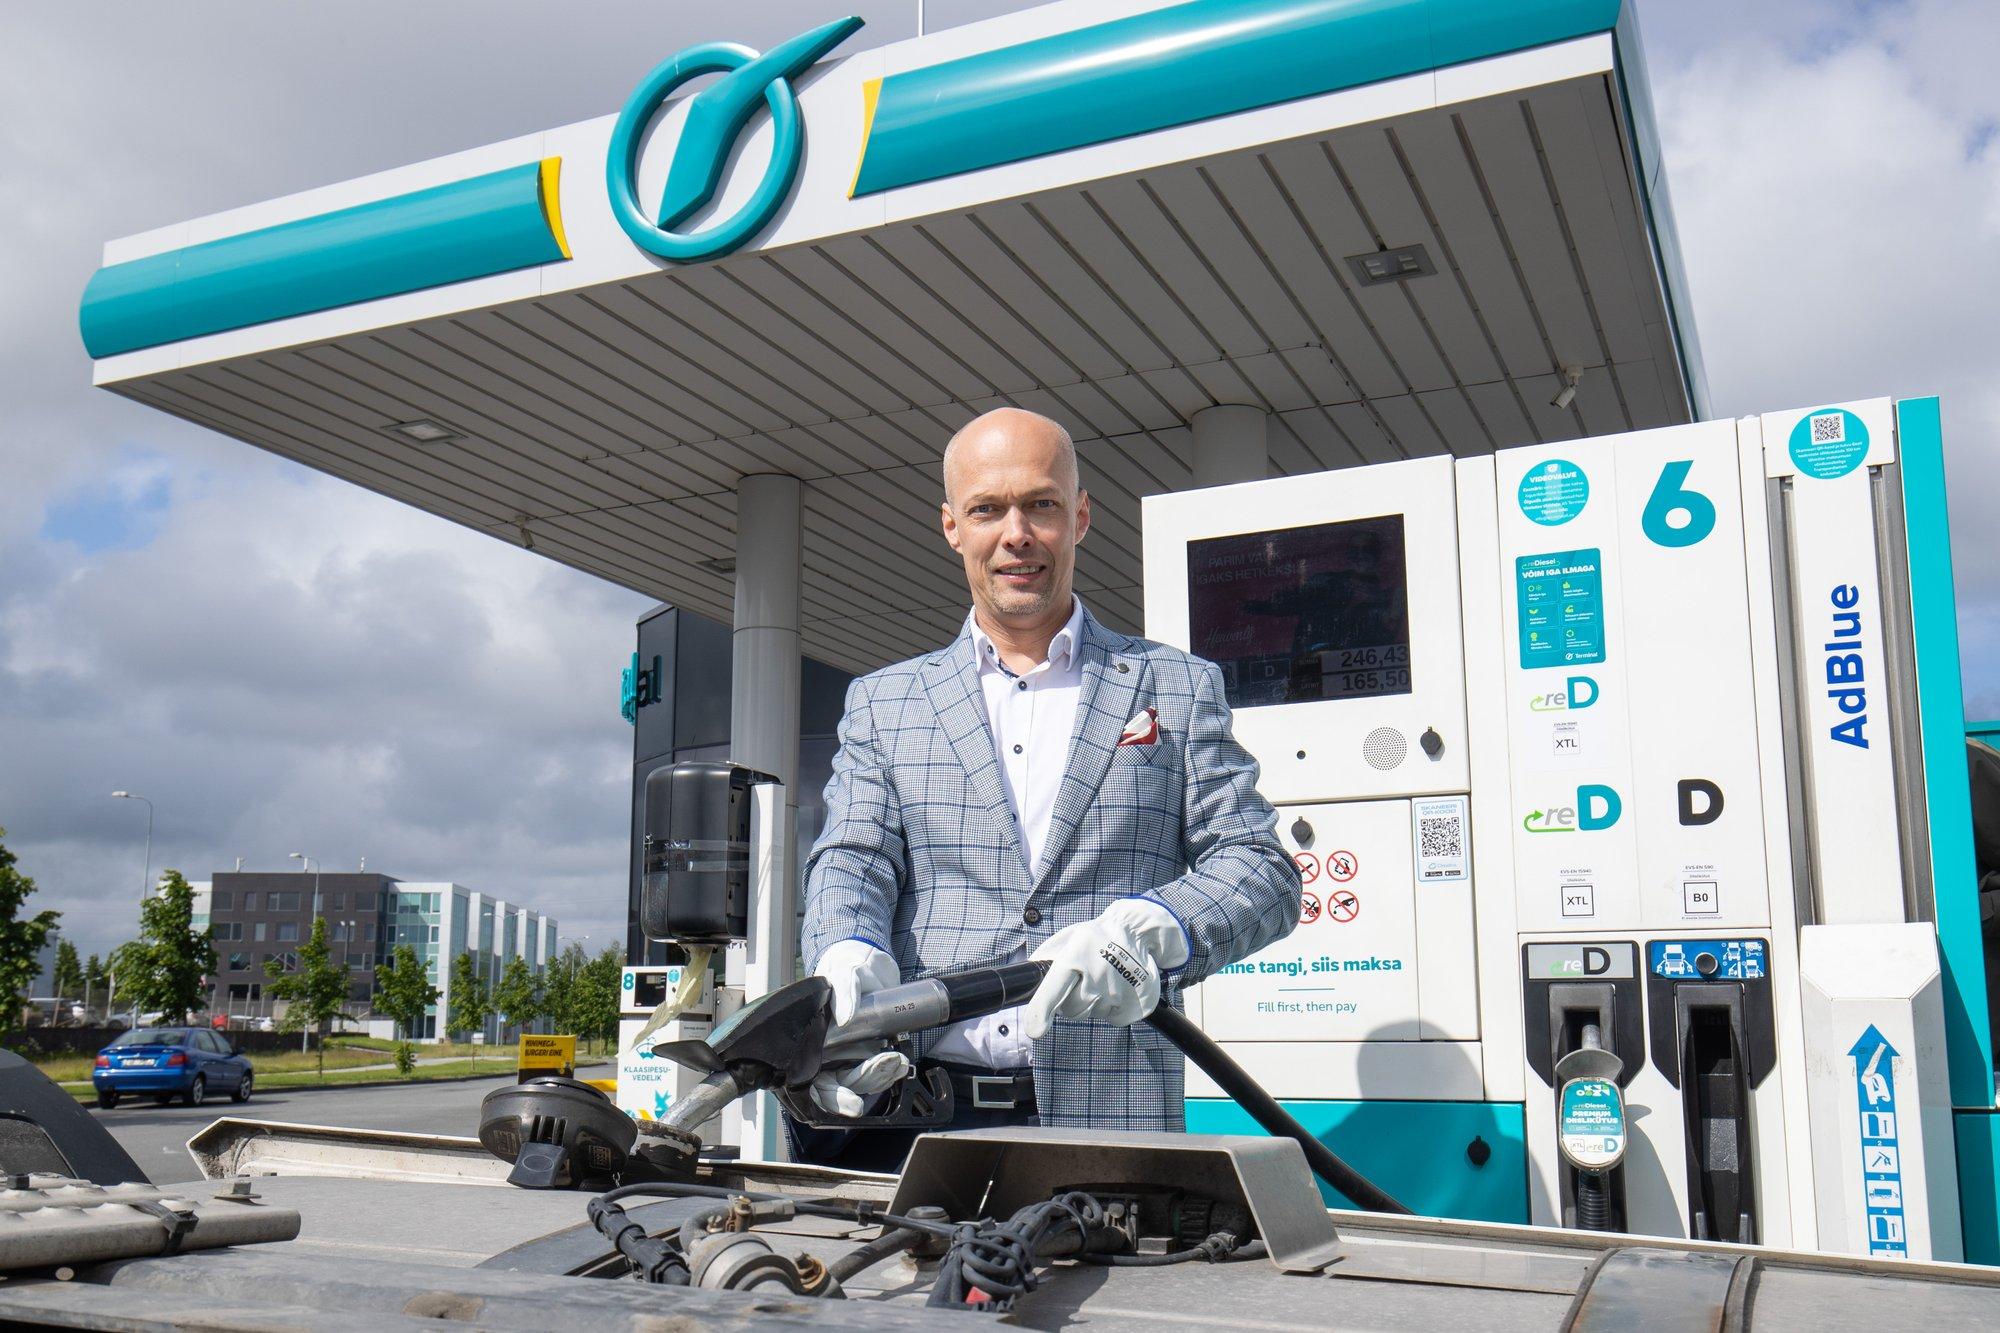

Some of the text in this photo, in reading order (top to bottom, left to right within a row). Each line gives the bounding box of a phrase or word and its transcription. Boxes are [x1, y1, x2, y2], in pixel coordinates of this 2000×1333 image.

[1529, 471, 1578, 483] VIDEOVALVE
[1642, 460, 1716, 548] 6
[1522, 564, 1596, 578] VÕIM IGA ILMAGA
[1341, 646, 1408, 668] 246,43
[1824, 584, 1870, 749] AdBlue
[1342, 669, 1409, 691] 165,50
[1545, 676, 1600, 710] reD
[1556, 738, 1578, 748] XTL
[1544, 784, 1622, 832] reD
[1678, 778, 1724, 826] D
[1566, 896, 1588, 906] XTL
[1694, 893, 1708, 902] B0
[1217, 957, 1402, 976] nne tangi, siis maksa
[1563, 947, 1611, 975] reD
[623, 972, 634, 990] 8
[894, 1005, 906, 1013] ZVA
[1257, 1001, 1357, 1013] Fill first, then pay
[624, 1066, 671, 1074] KLAASIPESU-
[632, 1074, 662, 1082] VEDELIK
[1593, 1138, 1618, 1152] reD
